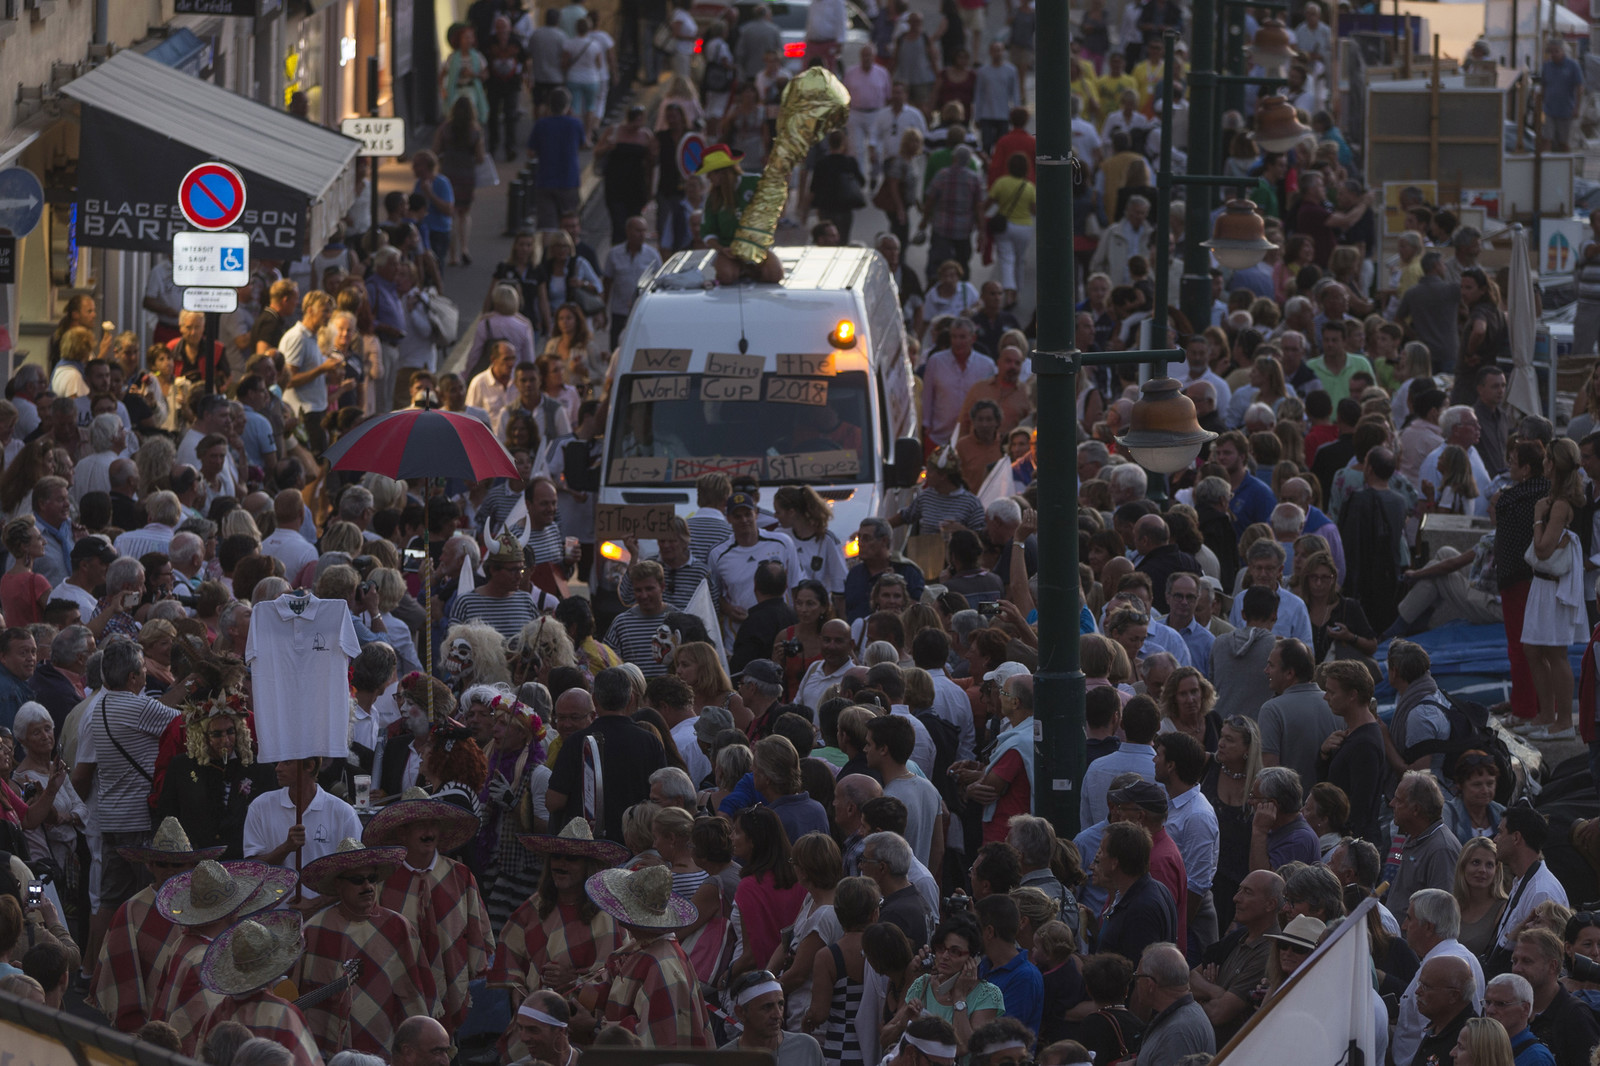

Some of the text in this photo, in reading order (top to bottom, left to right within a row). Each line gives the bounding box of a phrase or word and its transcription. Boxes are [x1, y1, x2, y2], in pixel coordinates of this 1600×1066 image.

[353, 122, 393, 135] SAUF
[358, 139, 394, 152] AXIS
[643, 349, 830, 379] We bring the
[636, 376, 826, 404] World Cup 2018
[618, 460, 649, 480] to
